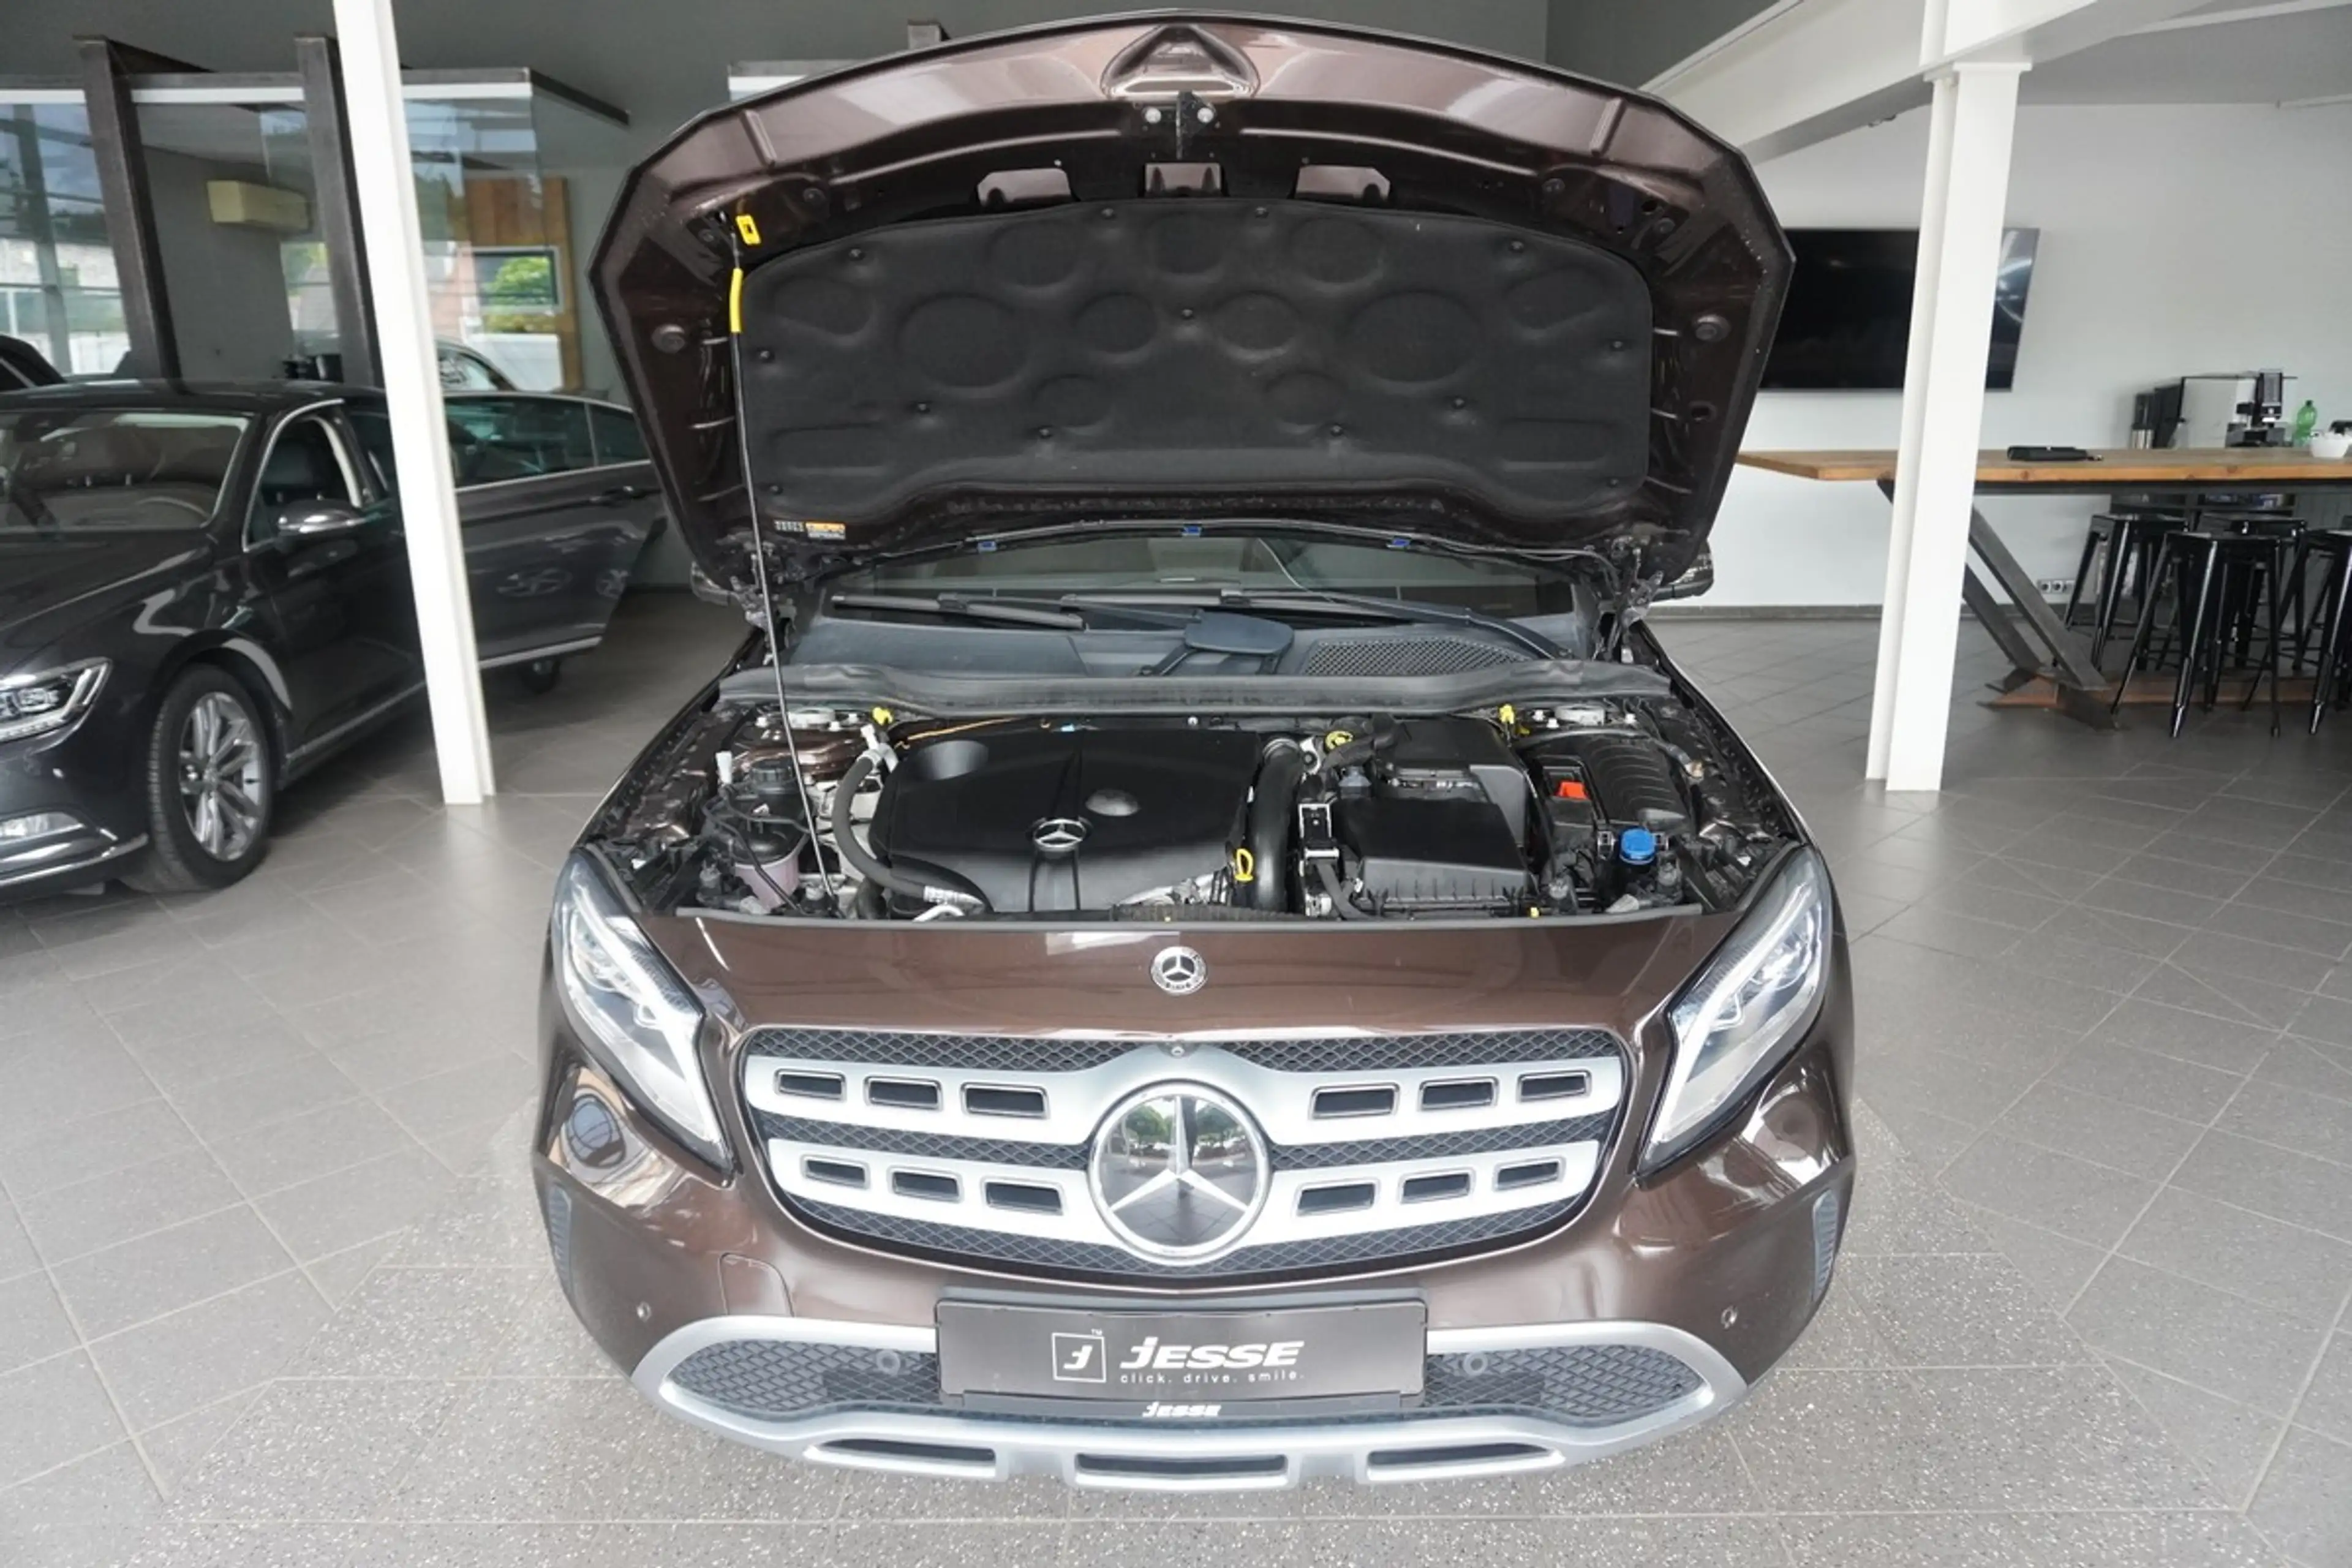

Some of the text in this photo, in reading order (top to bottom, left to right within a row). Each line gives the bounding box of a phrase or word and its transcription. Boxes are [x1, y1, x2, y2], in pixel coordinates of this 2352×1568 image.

[1120, 1336, 1305, 1370] JESSE
[1120, 1369, 1305, 1384] click. drive. smile.
